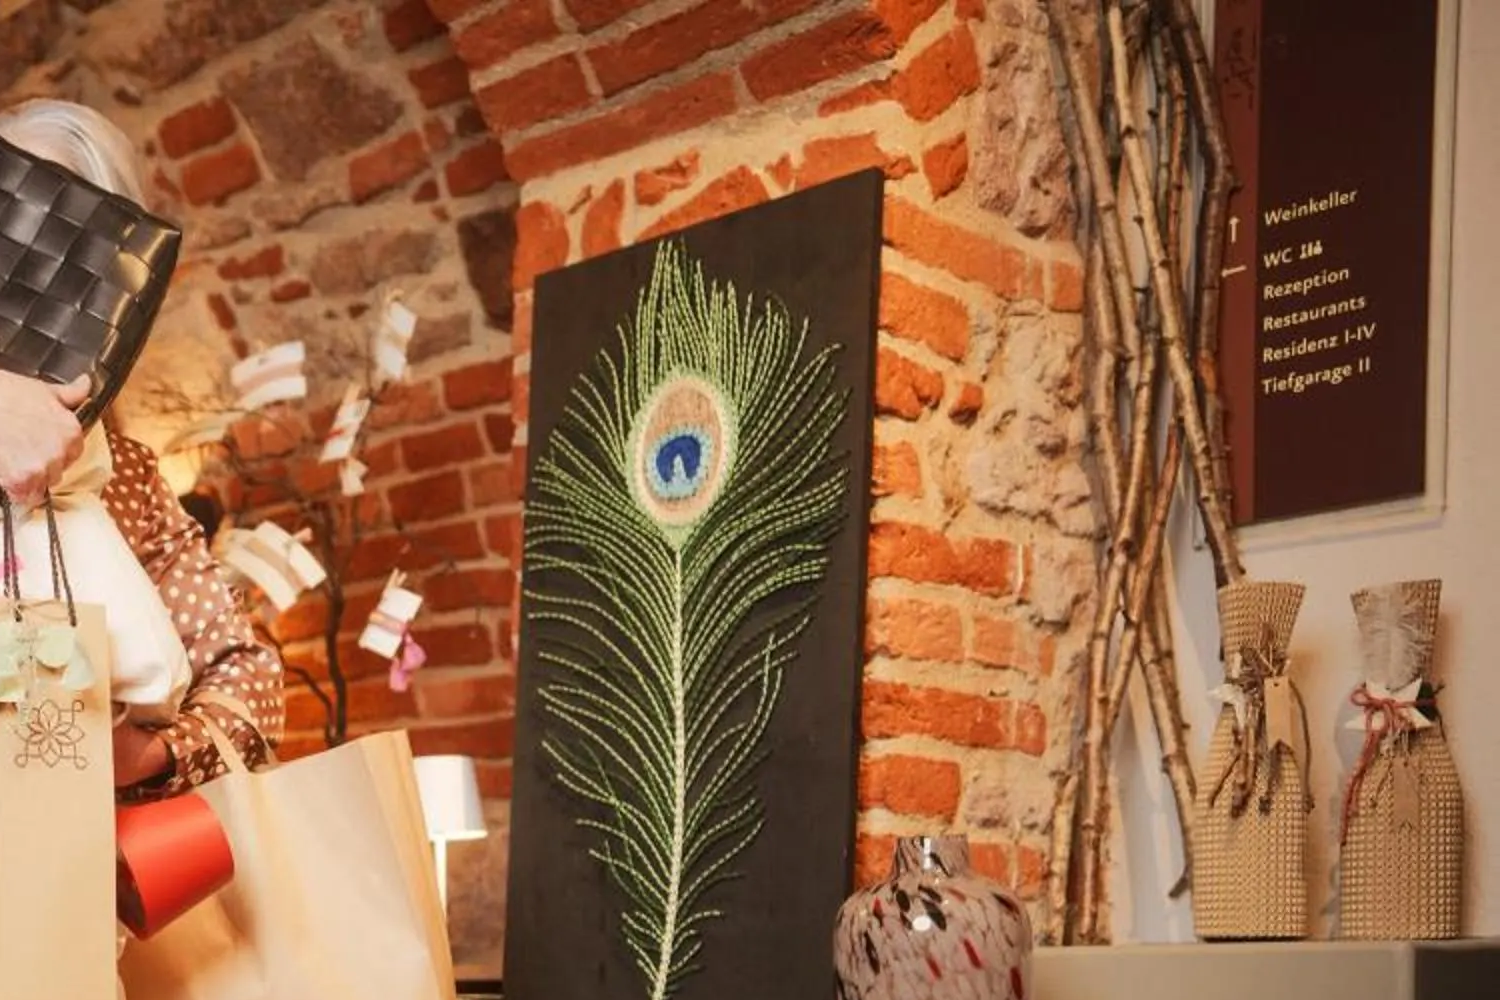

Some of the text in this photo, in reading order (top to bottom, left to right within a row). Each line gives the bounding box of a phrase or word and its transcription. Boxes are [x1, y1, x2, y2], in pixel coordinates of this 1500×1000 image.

[1264, 189, 1358, 226] Weinkeller
[1263, 247, 1292, 269] WC
[1263, 268, 1349, 300] Rezeption
[1263, 296, 1366, 332] Restaurants
[1263, 322, 1376, 363] Residenz I-IV
[1261, 356, 1370, 394] Tiefgarage II
